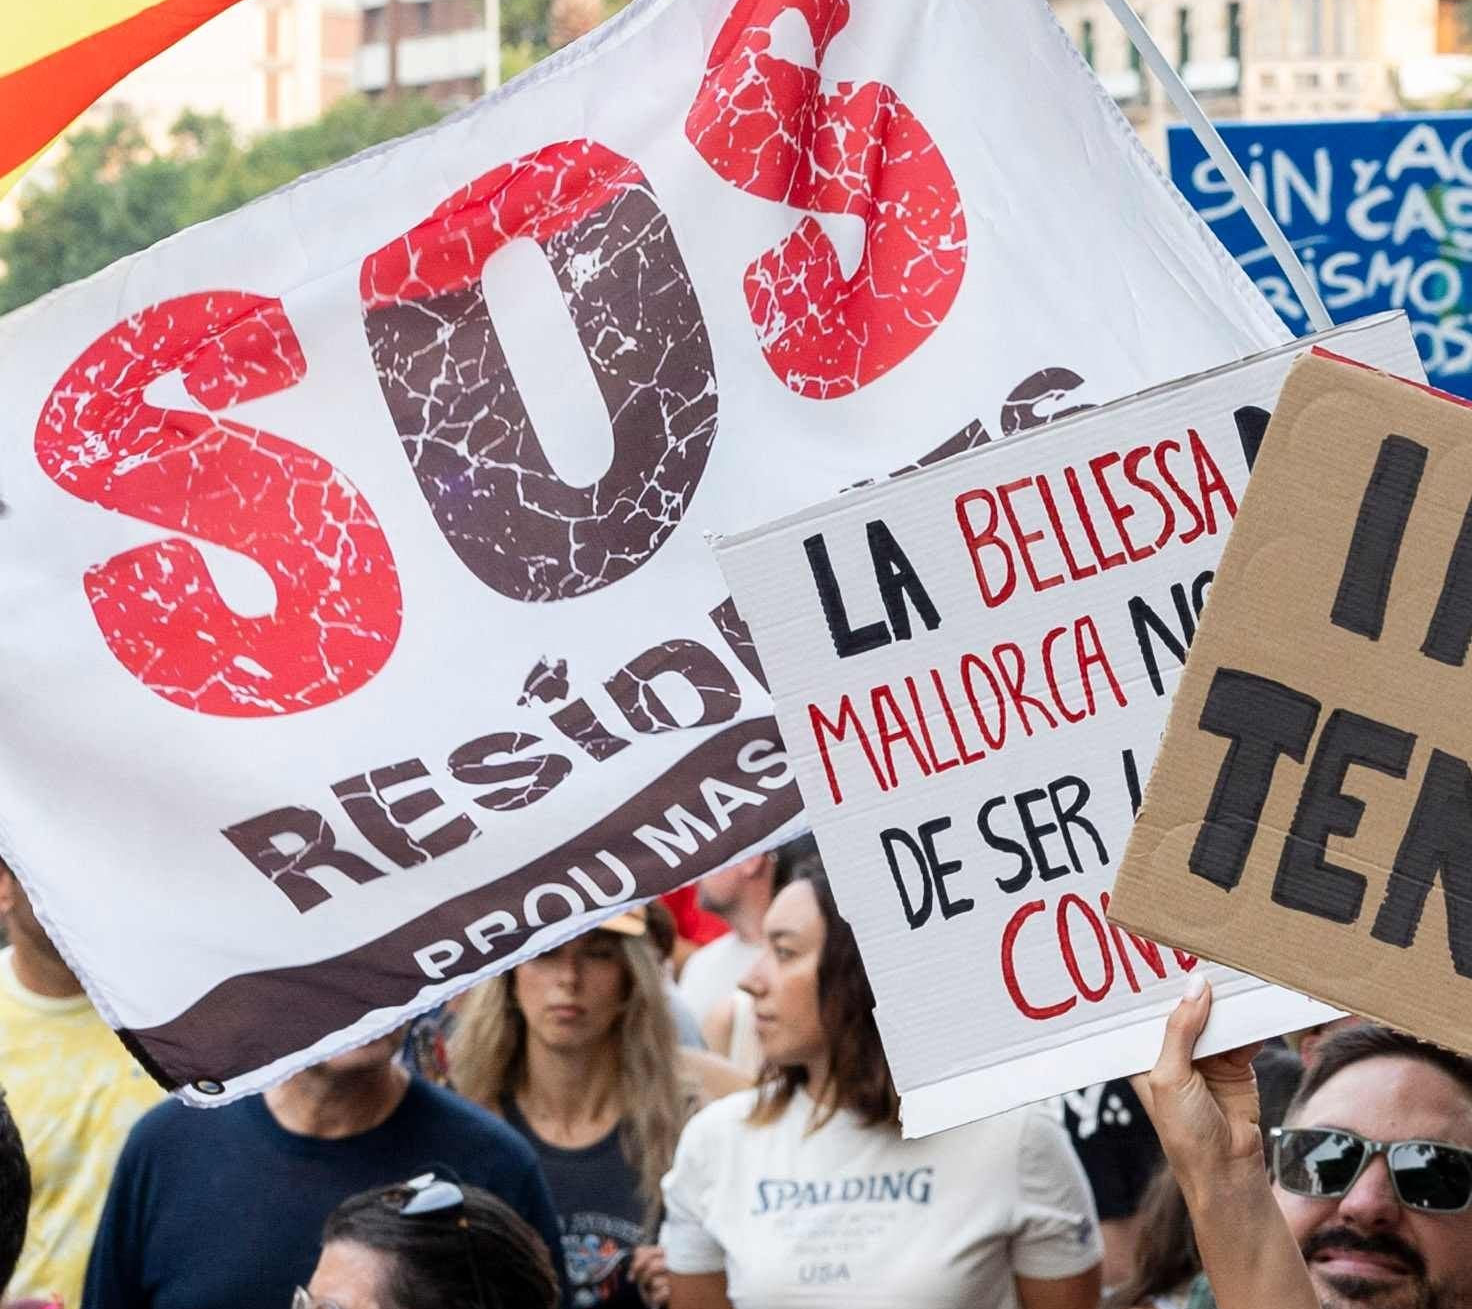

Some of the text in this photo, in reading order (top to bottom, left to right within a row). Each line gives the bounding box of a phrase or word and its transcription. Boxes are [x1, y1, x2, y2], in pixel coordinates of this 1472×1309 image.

[803, 518, 940, 660] LA
[954, 429, 1238, 608] BELLESSA
[809, 613, 1129, 804] MALLORCA
[413, 849, 637, 980] PROU
[880, 817, 974, 929] DE
[978, 776, 1108, 892] SER
